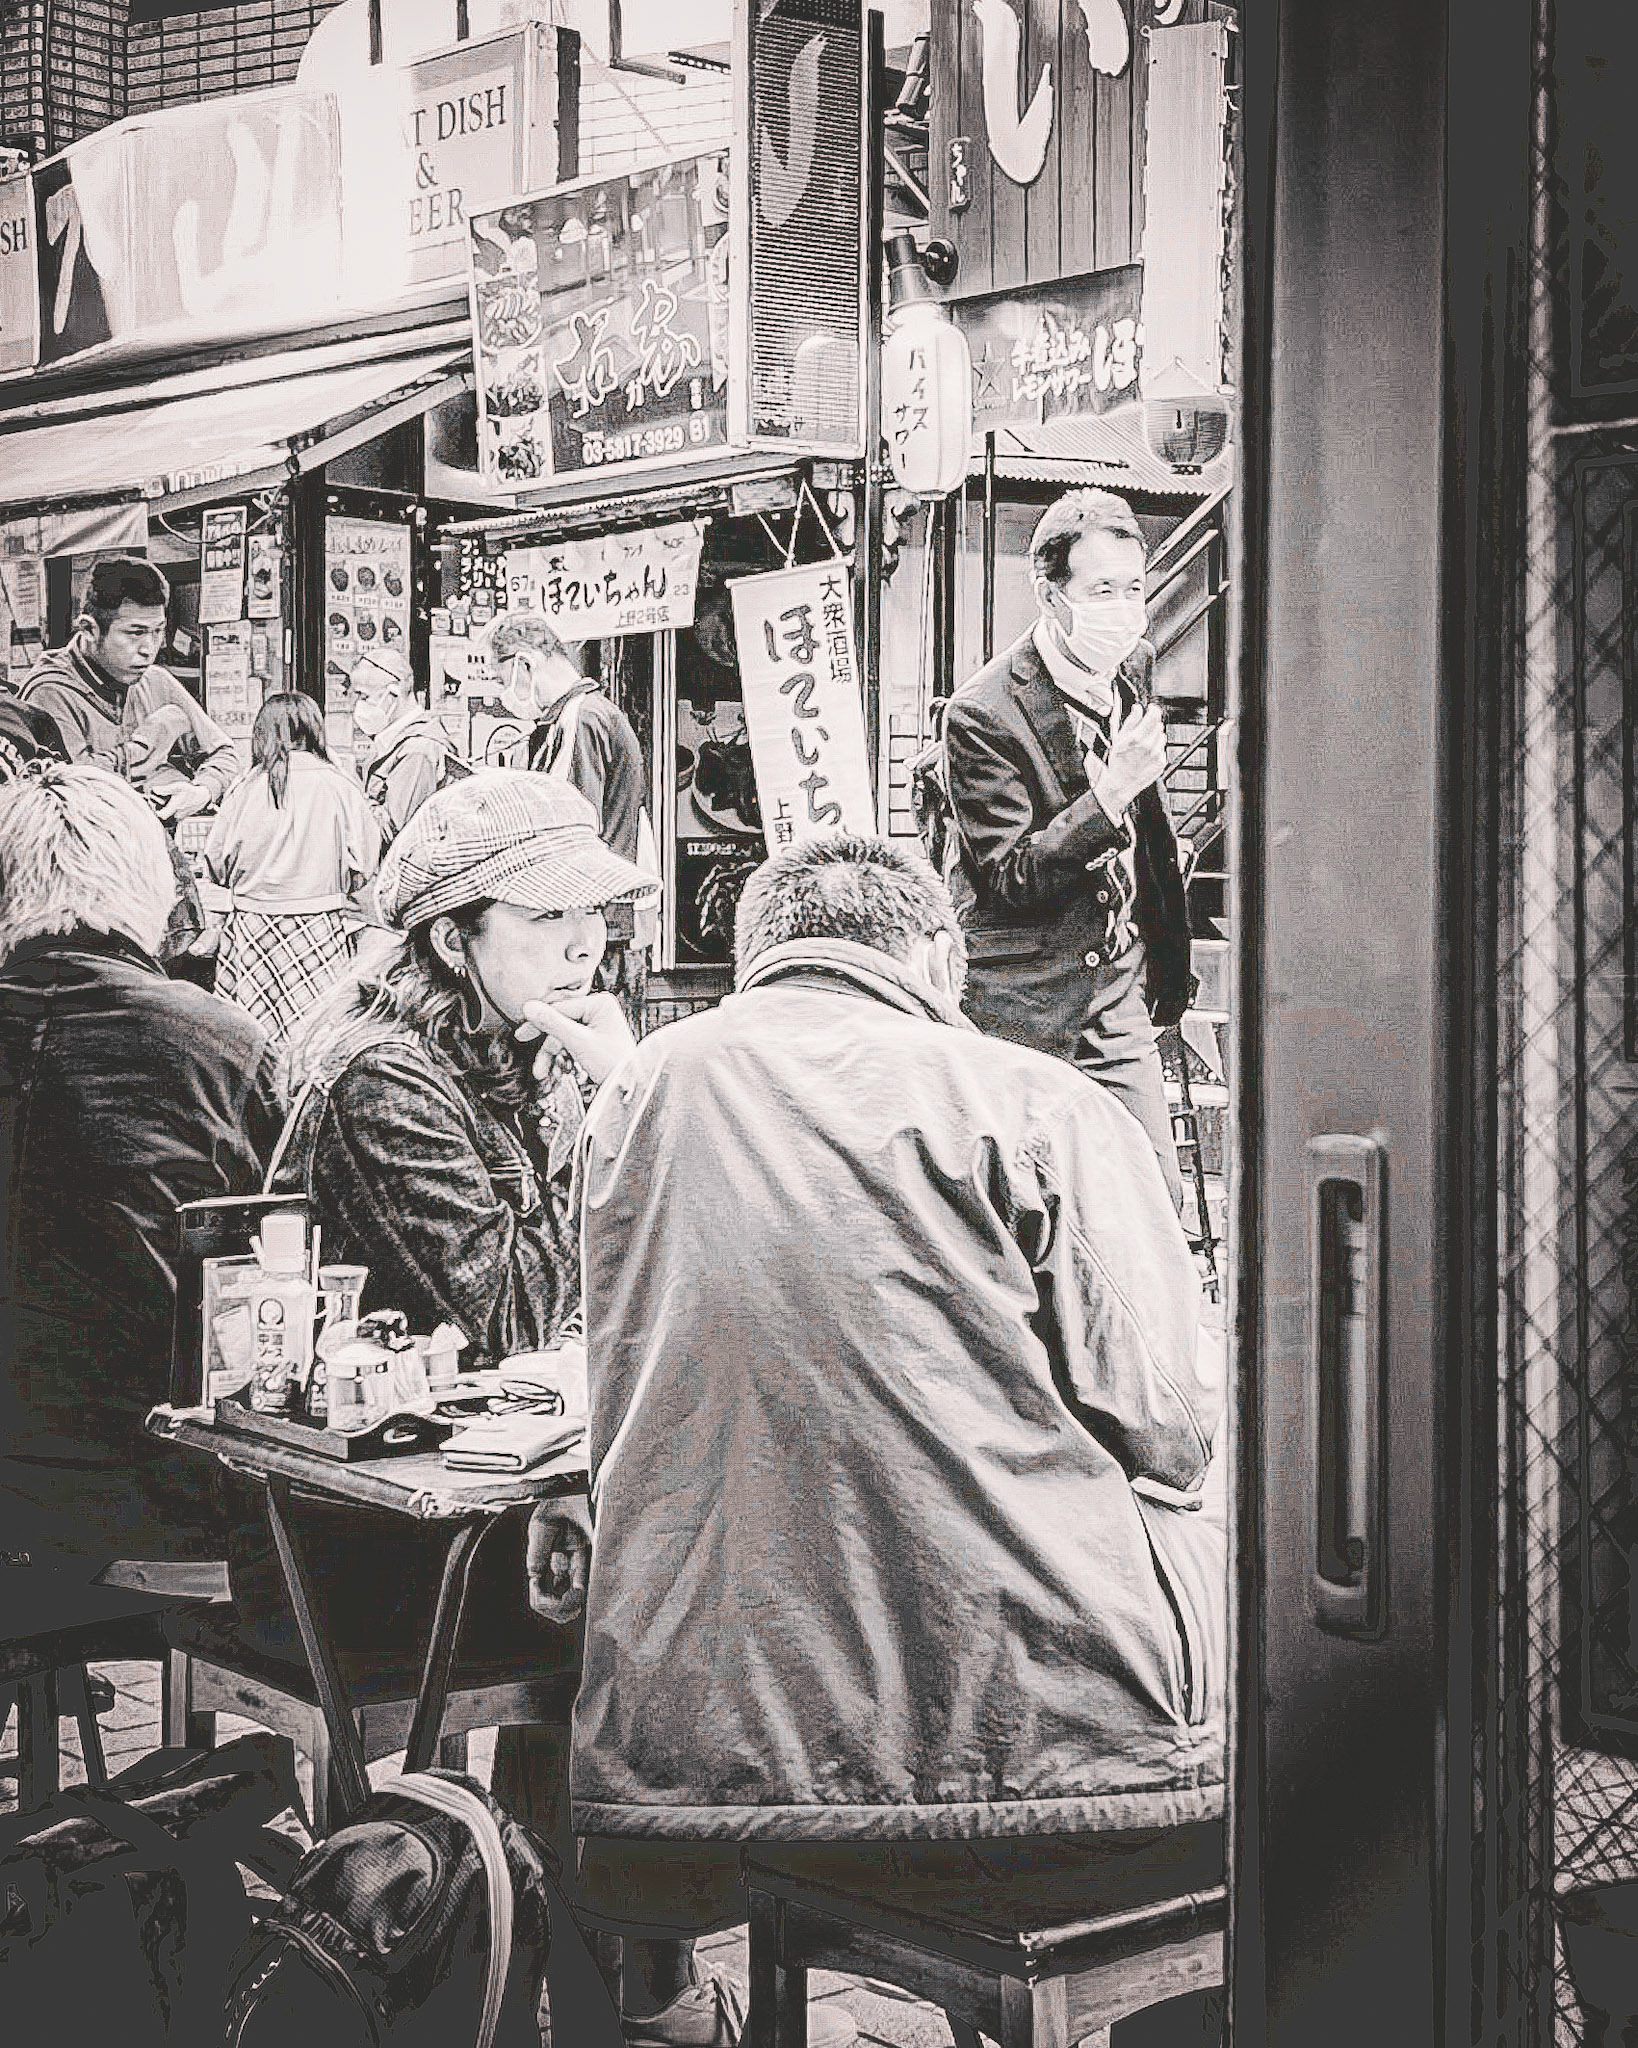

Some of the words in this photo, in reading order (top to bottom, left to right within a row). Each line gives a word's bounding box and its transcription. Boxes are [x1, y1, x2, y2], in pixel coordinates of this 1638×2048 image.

[436, 84, 507, 142] DISH
[415, 152, 439, 189] &
[409, 187, 464, 238] EER
[893, 403, 911, 469] サワー
[541, 563, 667, 615] ほていちゃん
[819, 575, 852, 683] 大衆酒場
